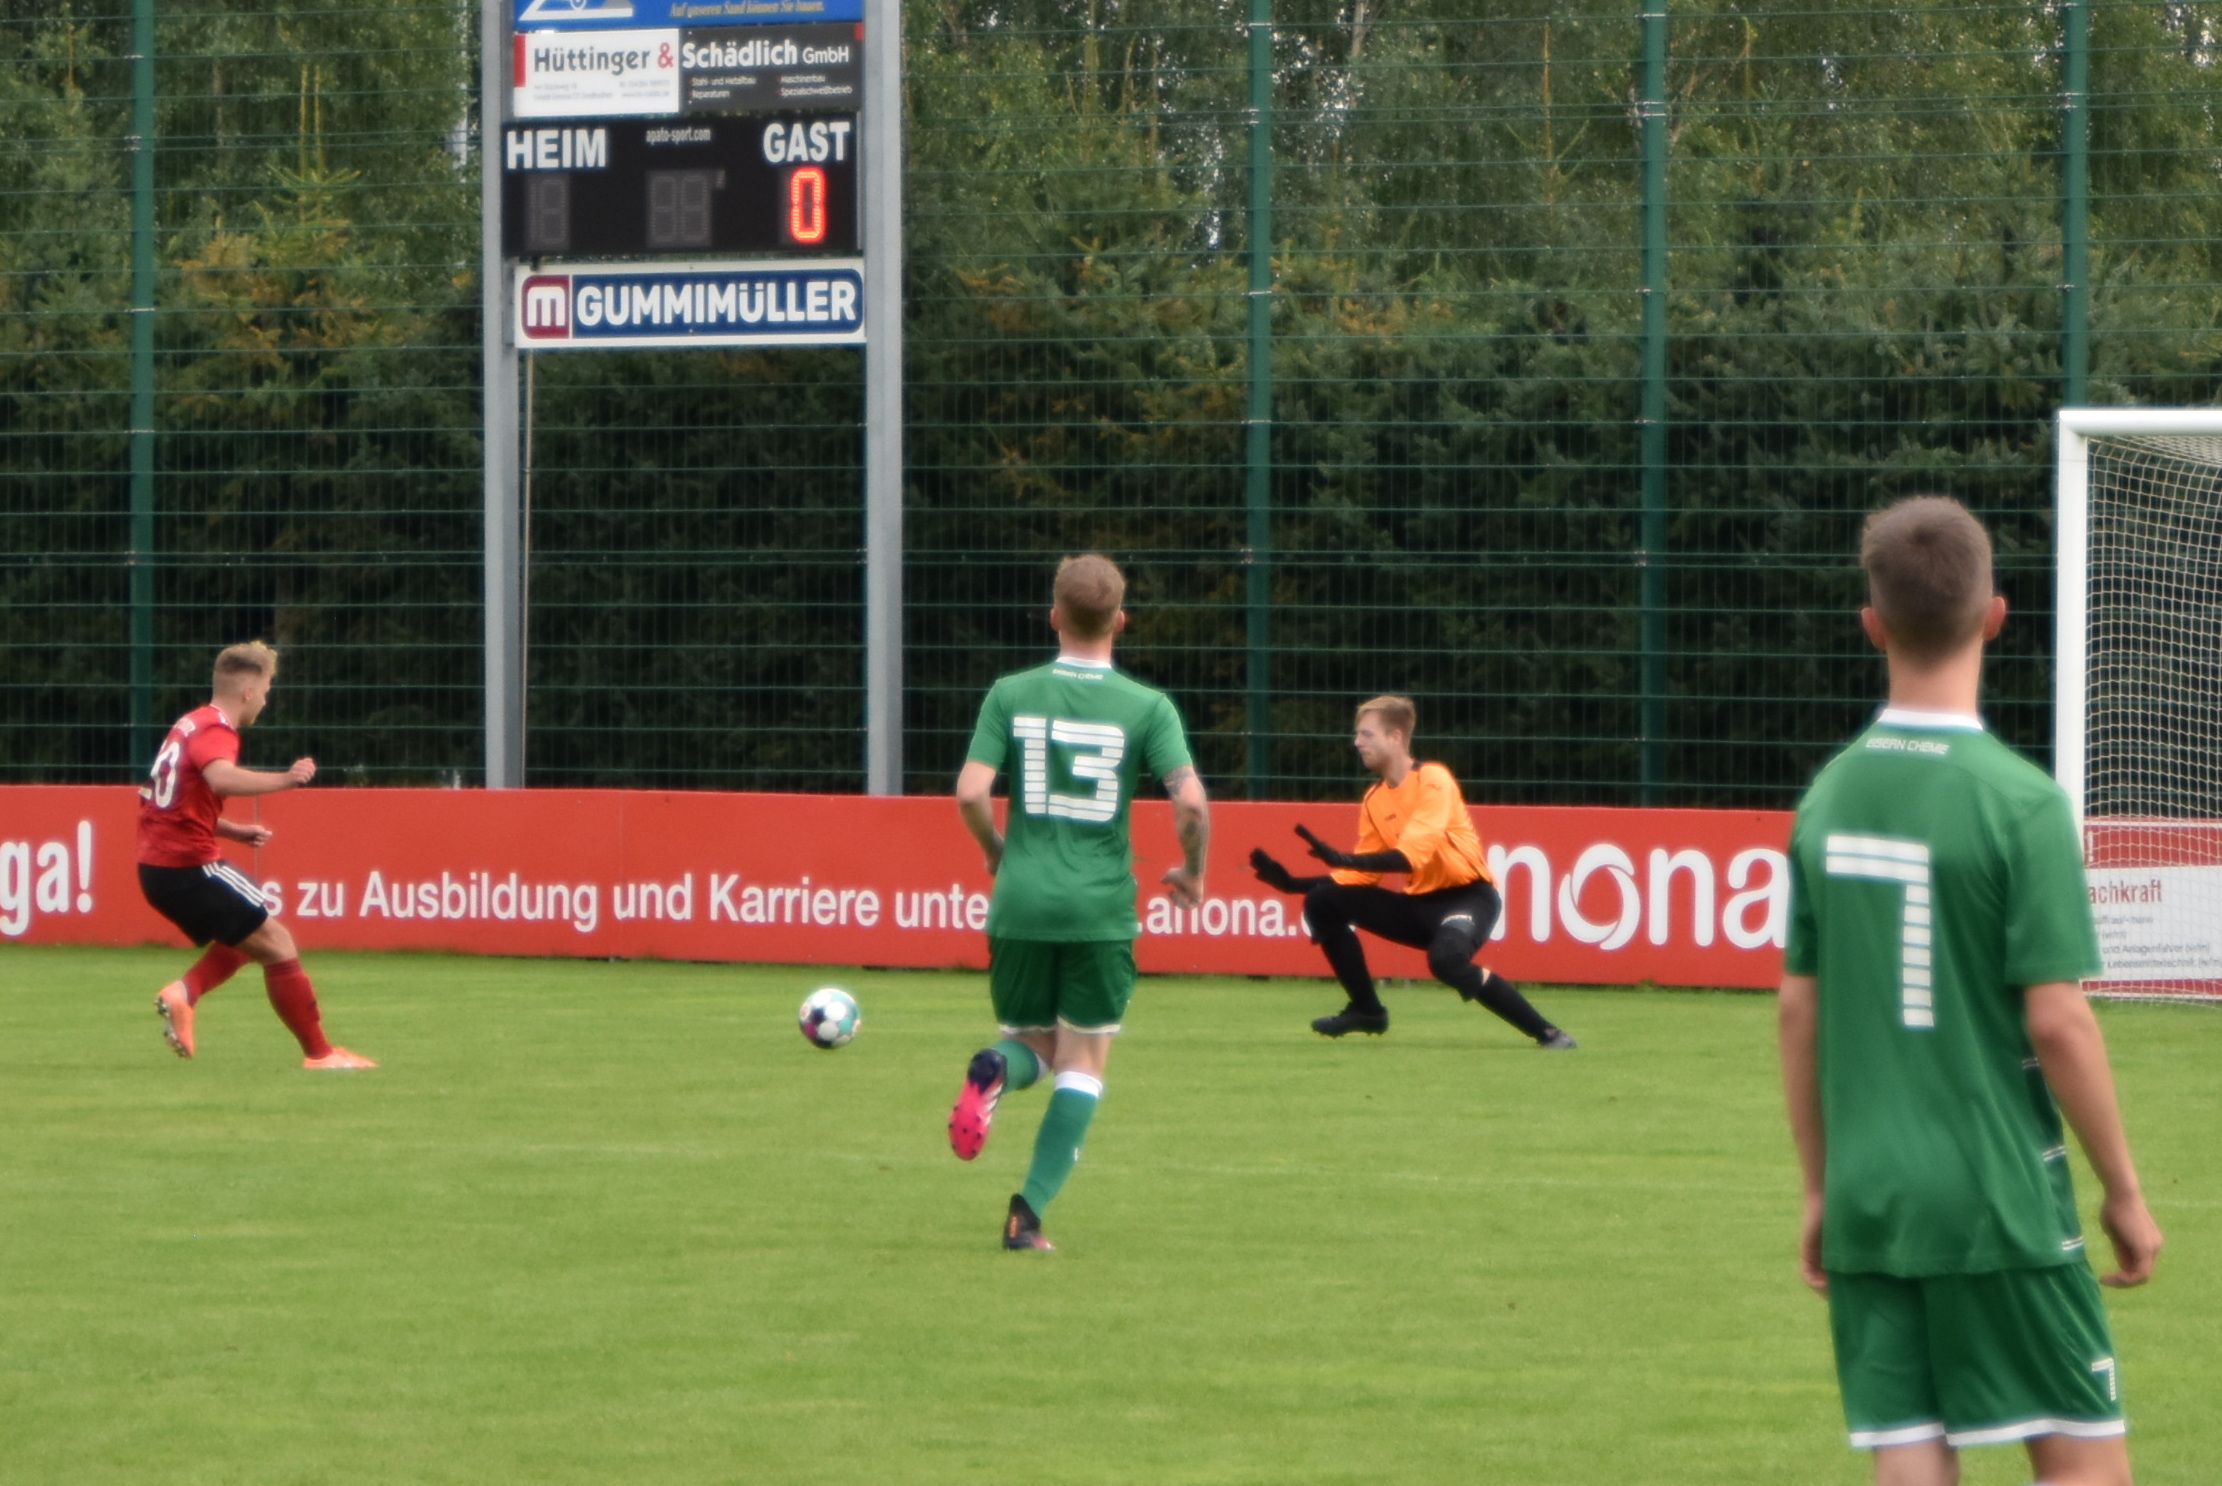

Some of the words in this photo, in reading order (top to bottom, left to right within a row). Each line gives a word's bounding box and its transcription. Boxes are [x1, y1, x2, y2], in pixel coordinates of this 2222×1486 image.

[534, 46, 650, 76] Hüttinger
[657, 42, 674, 68] &
[682, 39, 798, 68] Schädlich
[802, 46, 849, 64] GmbH
[507, 128, 607, 169] HEIM
[763, 122, 851, 163] GAST
[790, 167, 825, 243] 0
[577, 281, 856, 327] GUMMIMÜLLER
[1013, 716, 1125, 822] 13
[297, 882, 344, 919] zu
[360, 870, 597, 933] Ausbildung
[614, 873, 692, 921] und
[710, 873, 880, 927] Karriere
[895, 884, 990, 931] unte
[1487, 843, 1791, 950] nona
[2088, 879, 2162, 904] achkraft
[1825, 833, 1935, 1029] 7
[2091, 1356, 2117, 1402] 7
